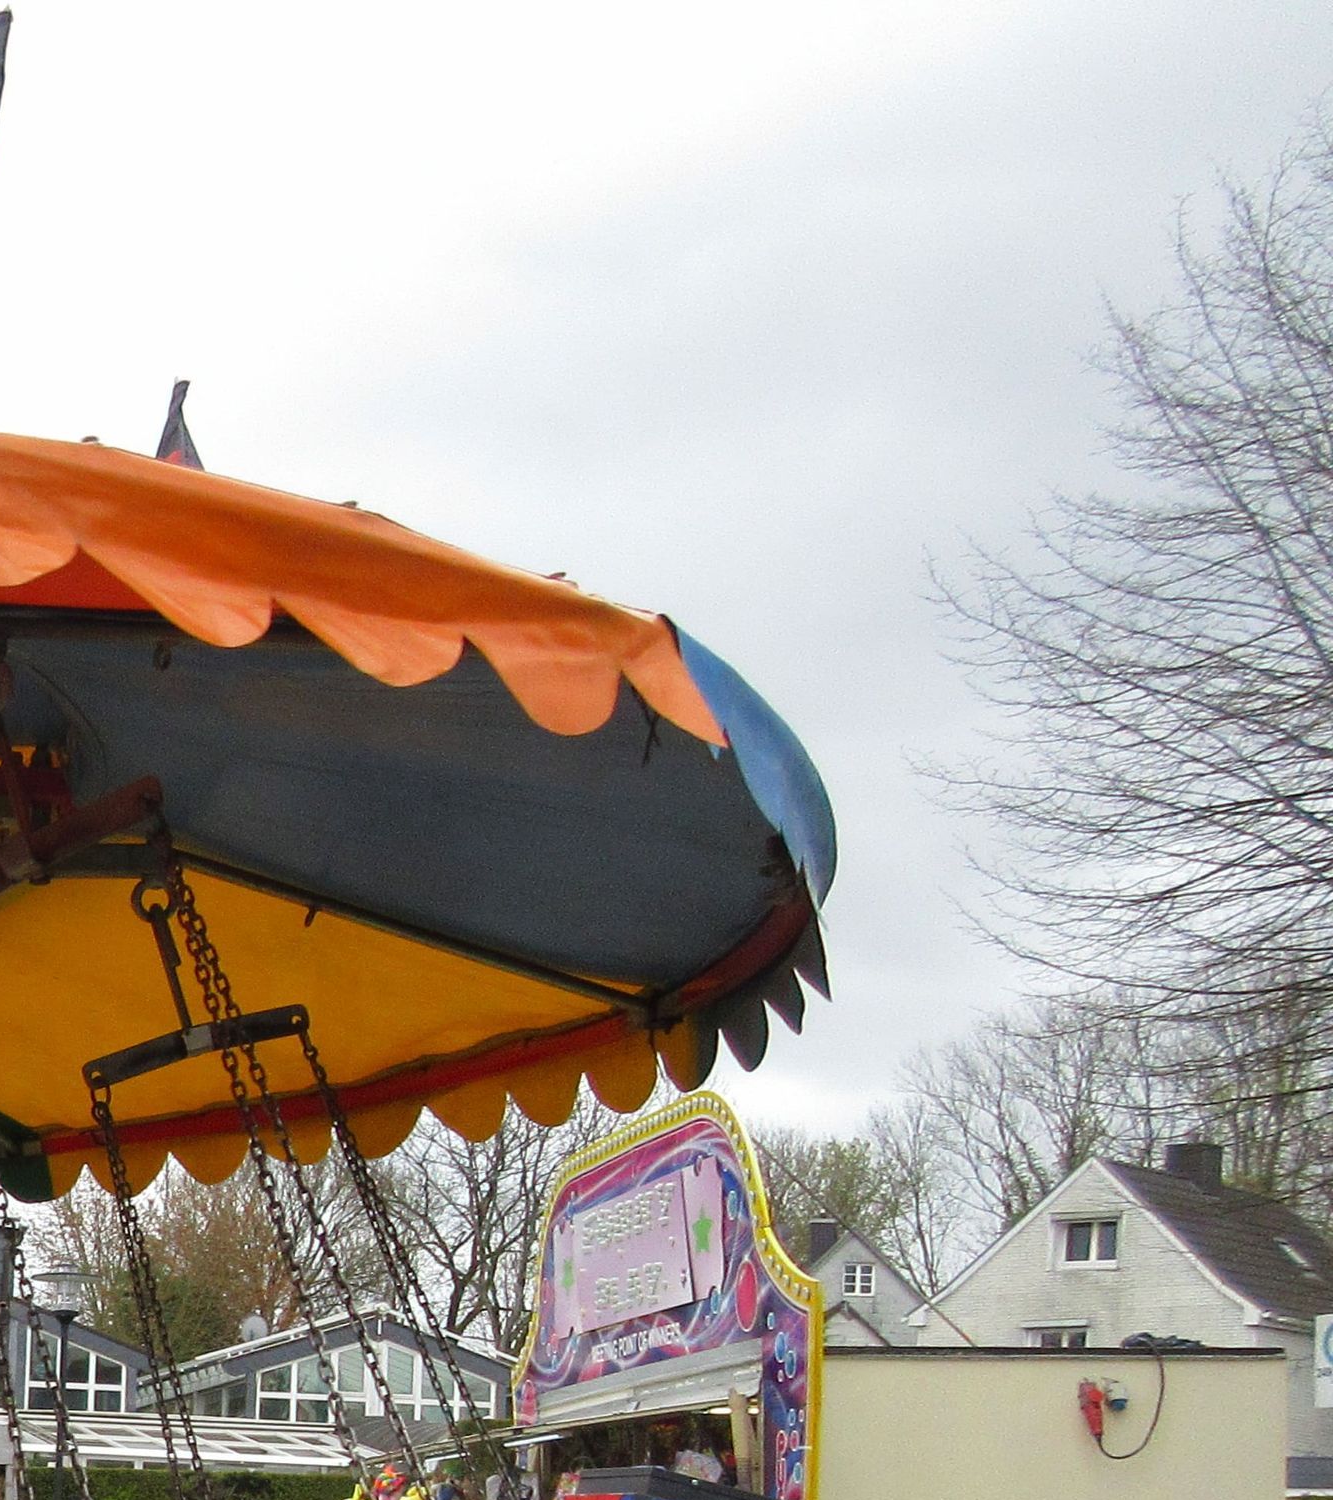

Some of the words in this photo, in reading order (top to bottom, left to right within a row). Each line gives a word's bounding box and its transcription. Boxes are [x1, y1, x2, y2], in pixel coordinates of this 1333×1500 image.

[619, 1332, 638, 1356] POINT
[638, 1330, 649, 1352] OF
[649, 1322, 682, 1349] WINNERS
